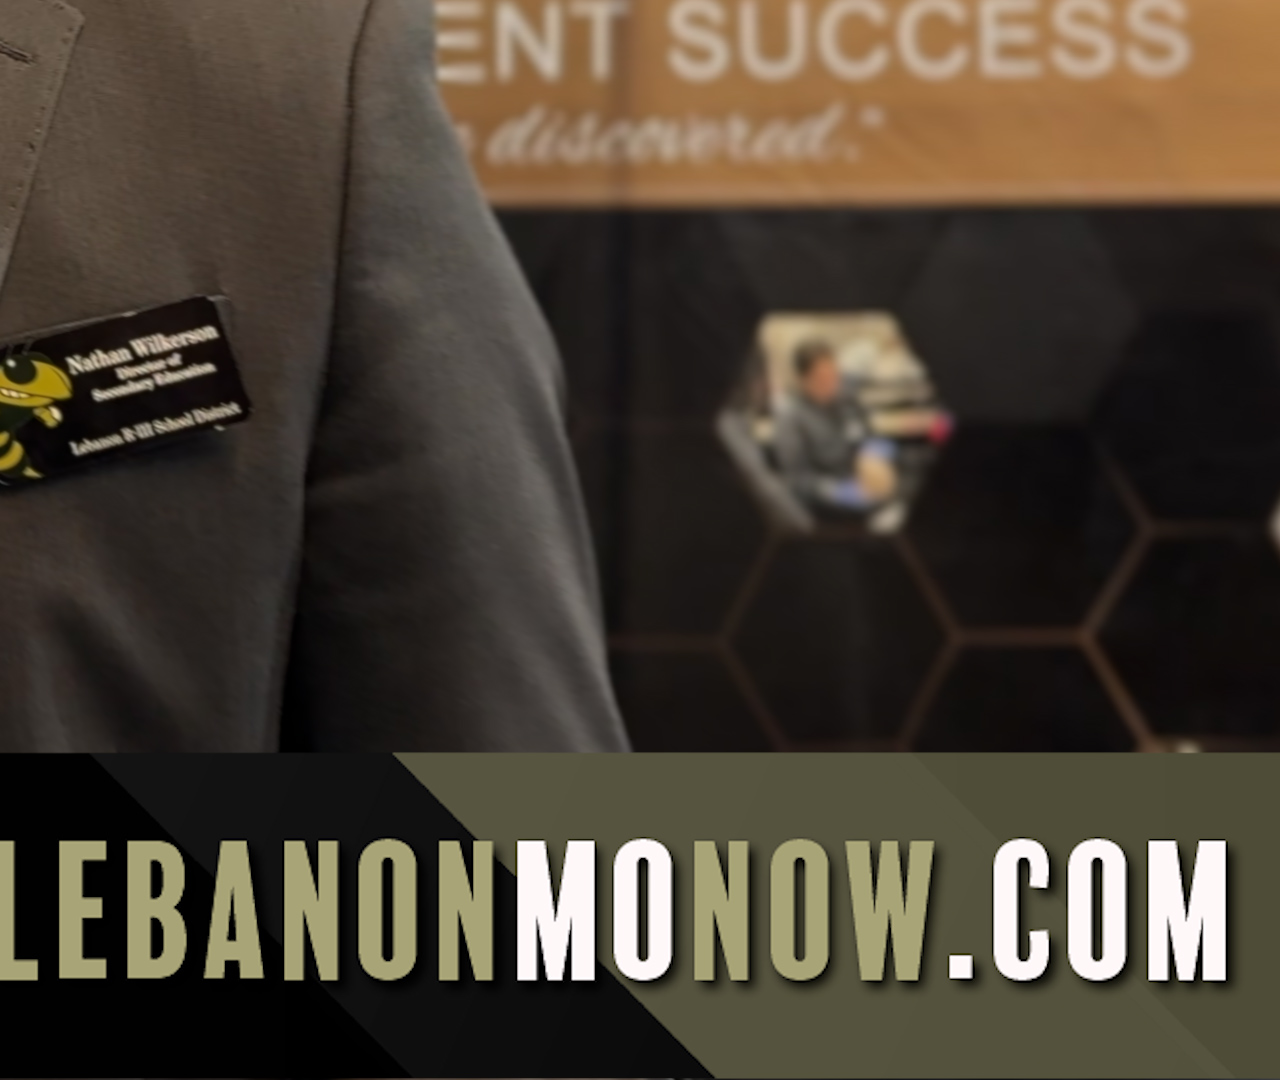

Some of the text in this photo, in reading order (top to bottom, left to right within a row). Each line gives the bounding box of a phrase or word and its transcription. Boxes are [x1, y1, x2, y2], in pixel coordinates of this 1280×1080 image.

[64, 325, 220, 376] Nathan Wilkerson
[68, 433, 126, 456] Lebanon
[152, 411, 196, 435] School
[191, 400, 242, 424] District
